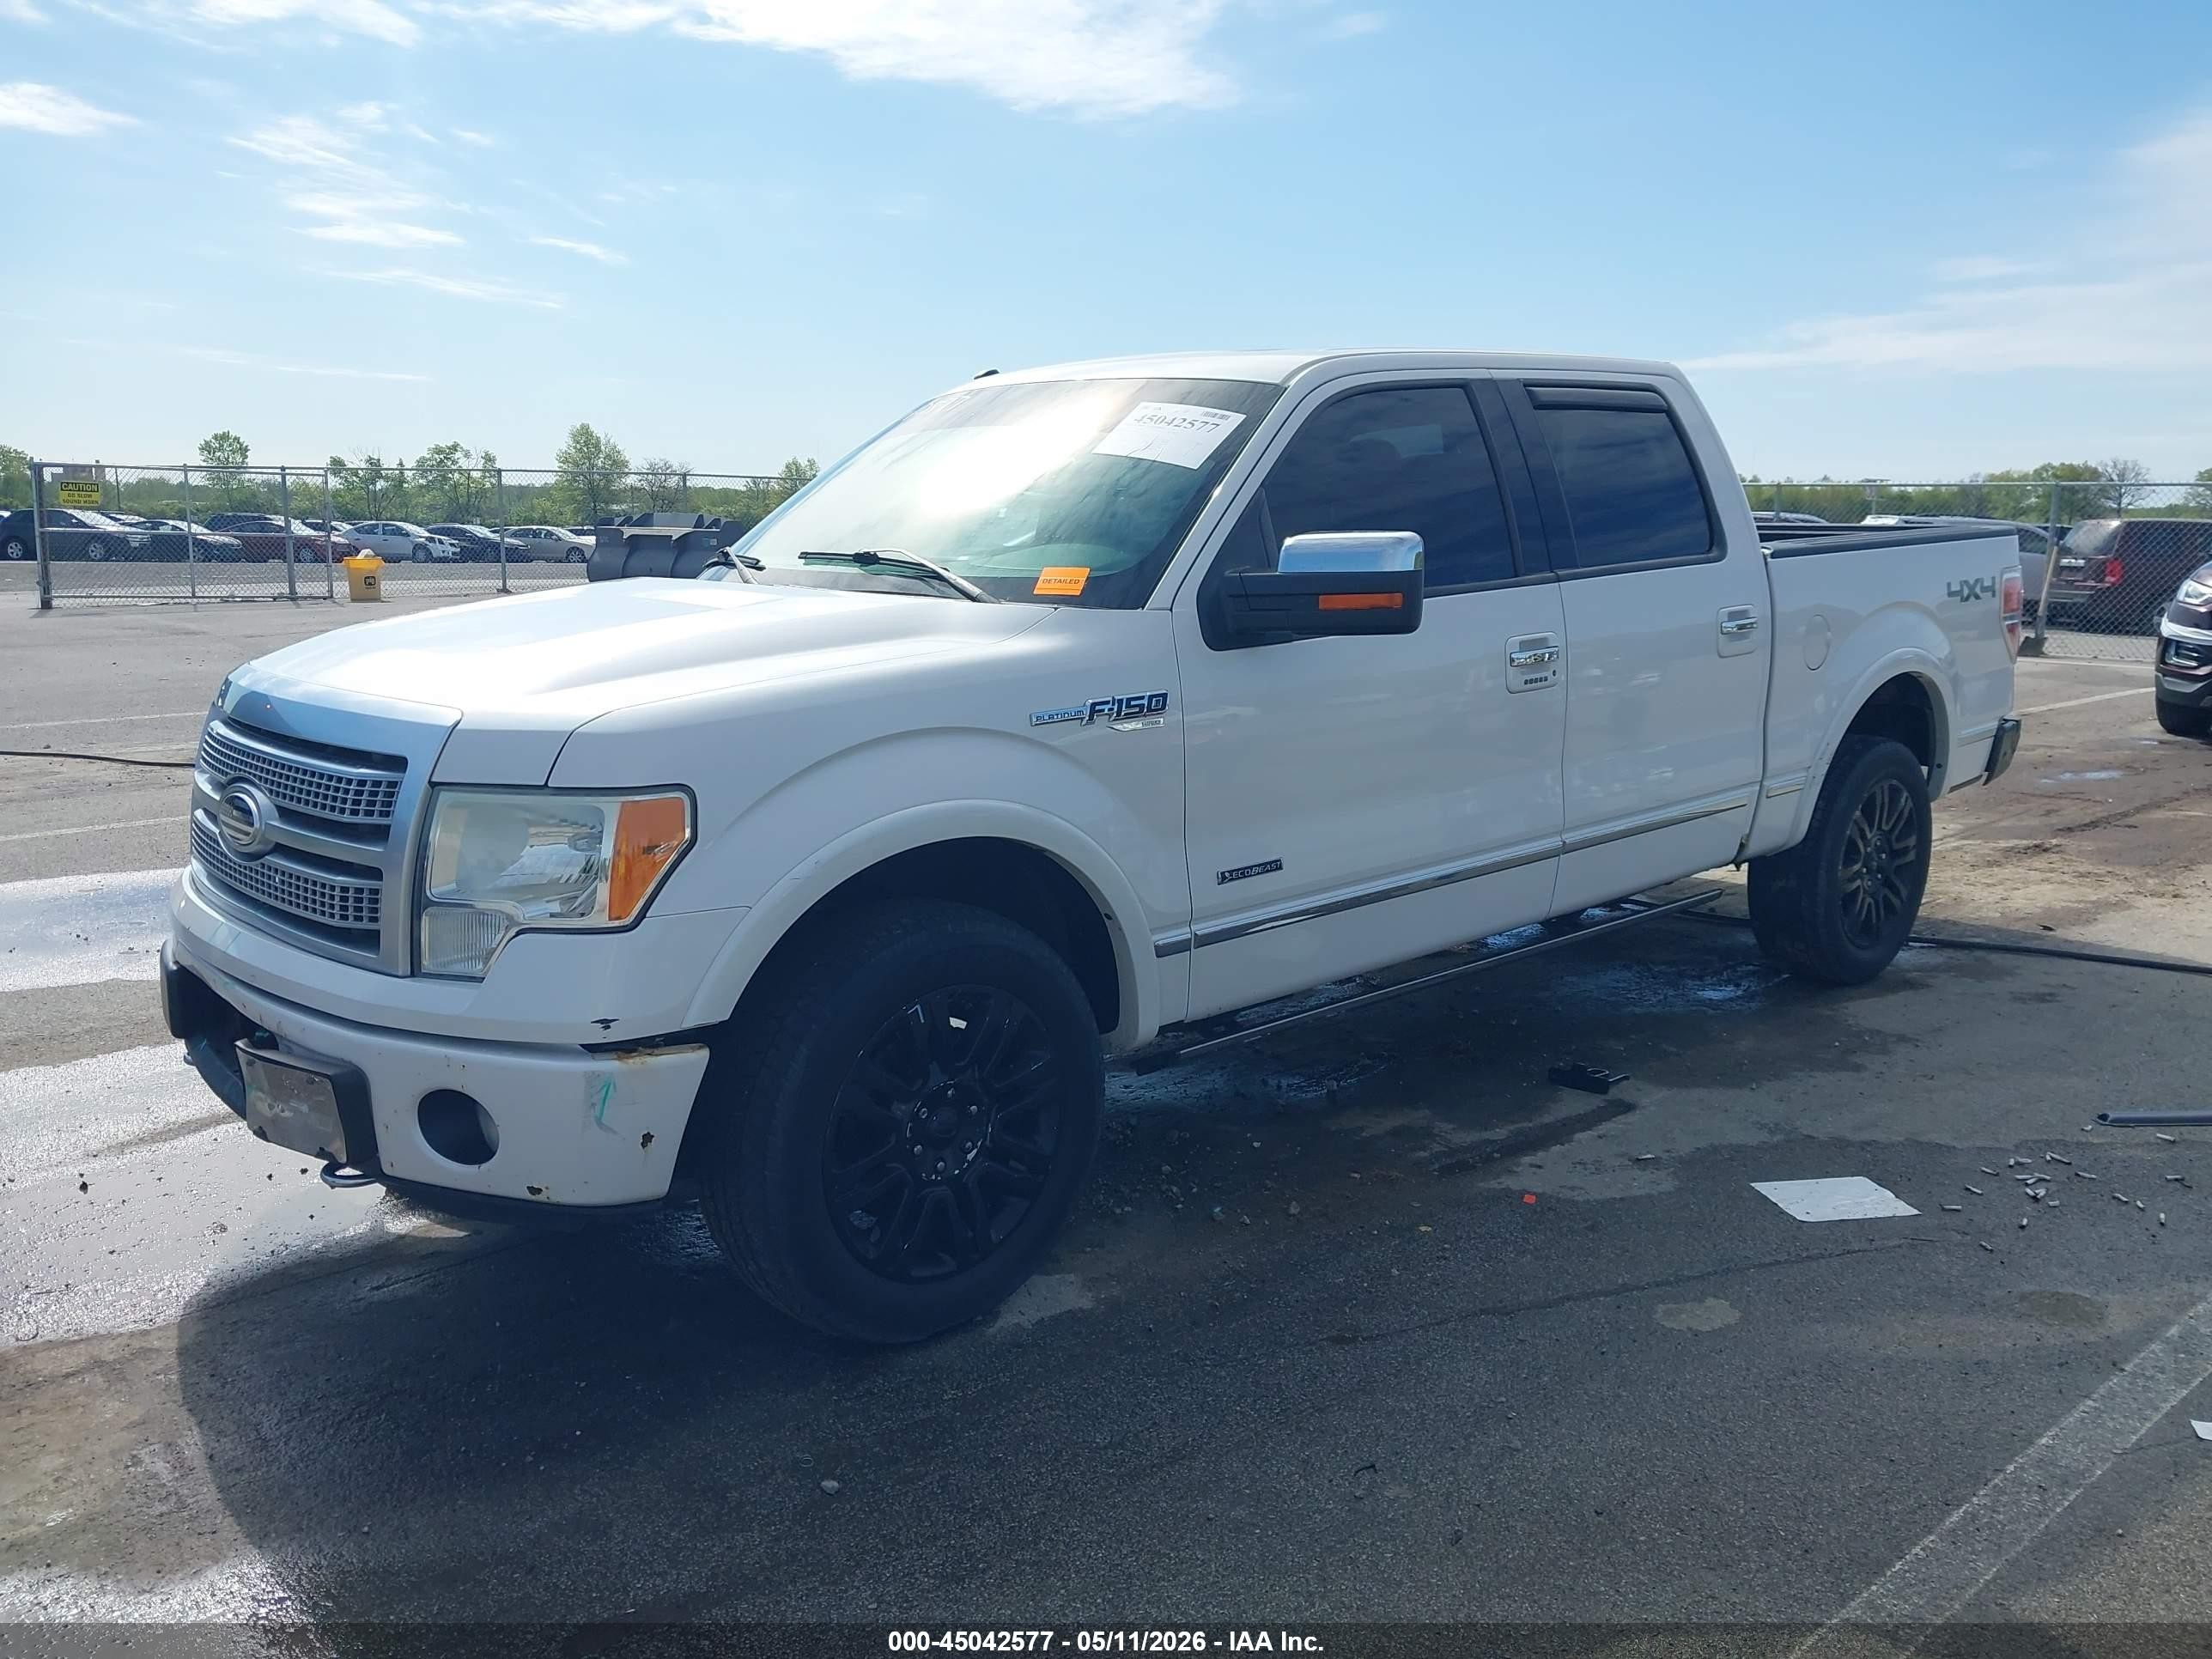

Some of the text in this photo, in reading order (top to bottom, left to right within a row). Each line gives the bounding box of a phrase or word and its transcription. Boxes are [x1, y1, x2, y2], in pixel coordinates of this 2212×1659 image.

[1133, 414, 1221, 434] 45042577
[62, 483, 98, 492] CAUTION
[1086, 690, 1169, 724] F-150
[1232, 860, 1282, 879] ECOBEAST
